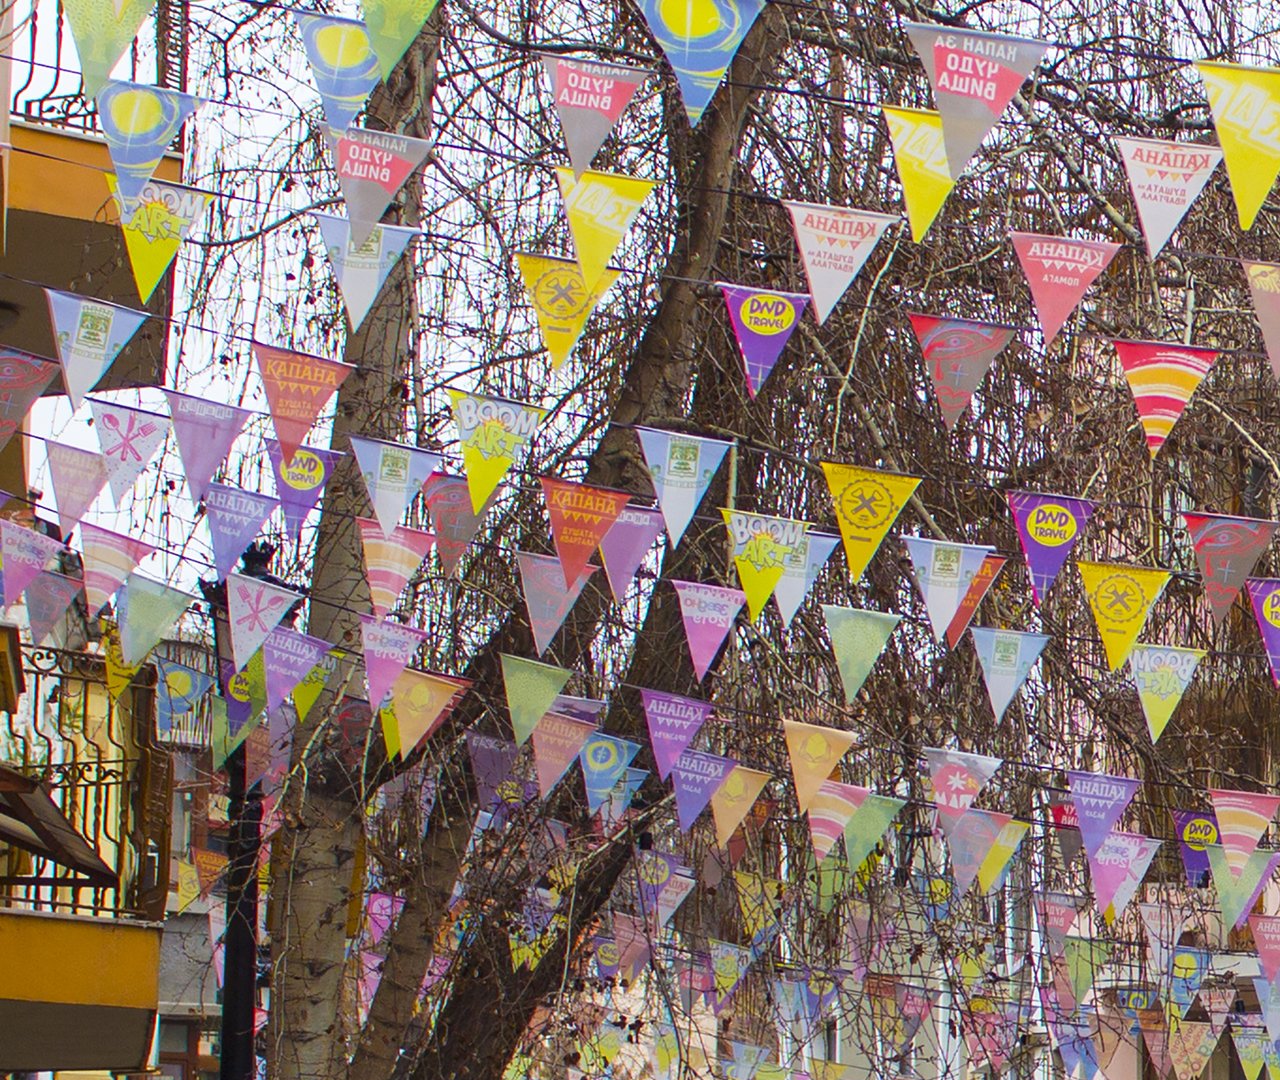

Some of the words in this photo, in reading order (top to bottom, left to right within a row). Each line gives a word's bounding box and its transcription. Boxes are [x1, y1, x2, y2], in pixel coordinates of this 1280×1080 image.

[129, 201, 191, 240] ART
[749, 298, 785, 316] DND
[748, 315, 784, 330] TRAVEL
[266, 359, 336, 385] КАПАНА
[458, 399, 538, 436] BOOM
[468, 423, 526, 459] ART
[285, 471, 317, 484] TRAVEL
[552, 488, 616, 516] КАПАНА
[731, 516, 807, 545] BOOM
[1035, 509, 1069, 527] DND
[1034, 526, 1067, 540] TRAVEL
[741, 538, 793, 568] ART
[1189, 821, 1213, 837] DND
